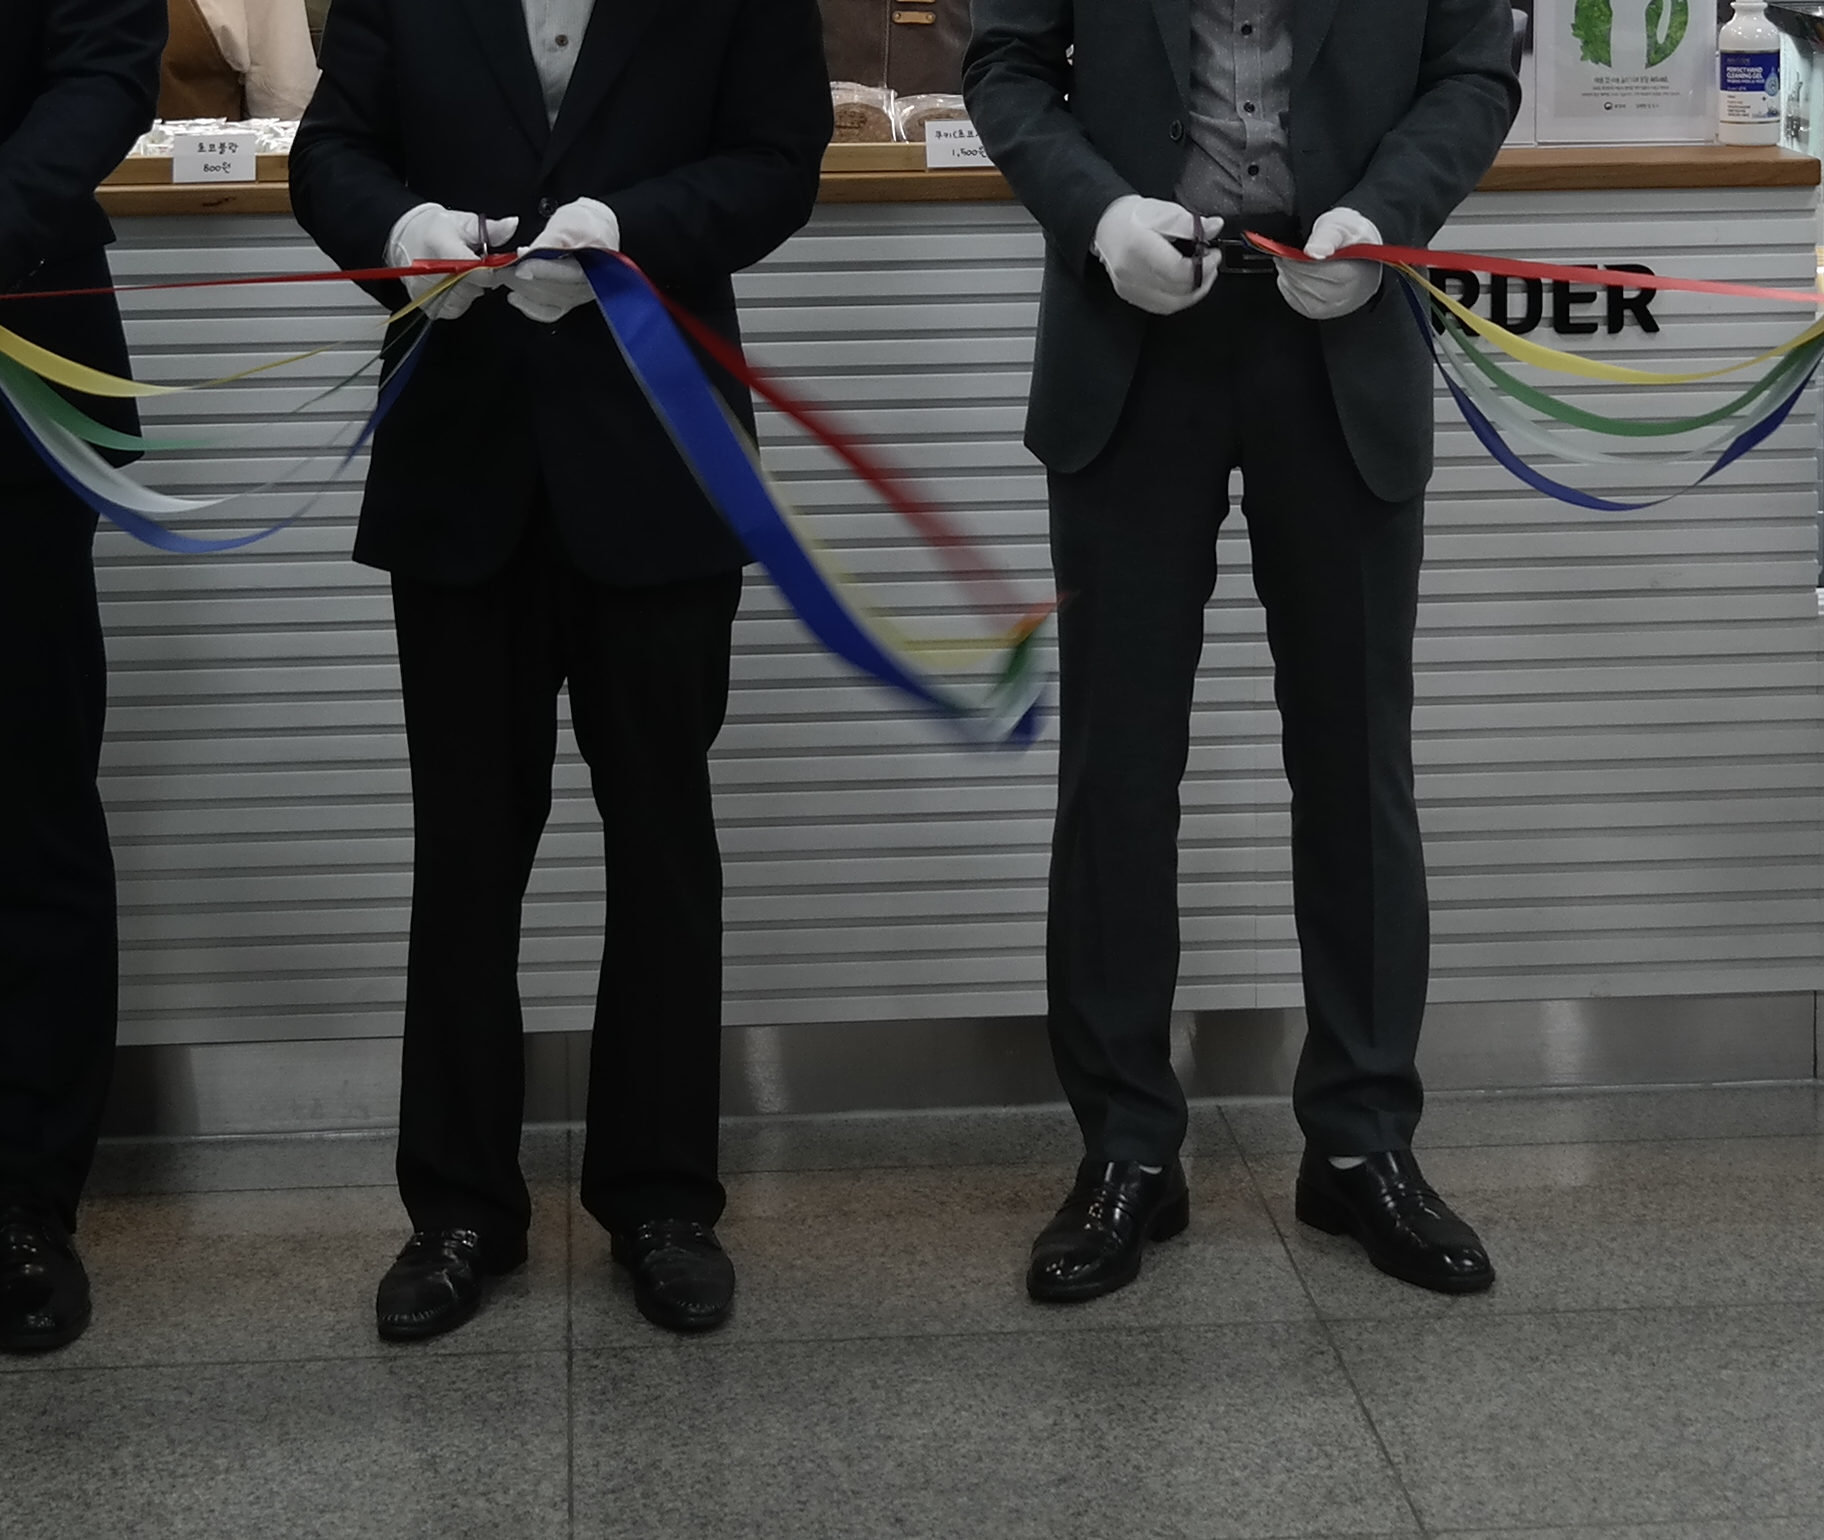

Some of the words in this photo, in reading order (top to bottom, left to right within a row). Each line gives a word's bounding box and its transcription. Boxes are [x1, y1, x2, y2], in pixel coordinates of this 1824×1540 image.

[934, 128, 979, 140] 쿠키(초코
[203, 161, 232, 174] 800원
[1428, 263, 1660, 337] RDER
